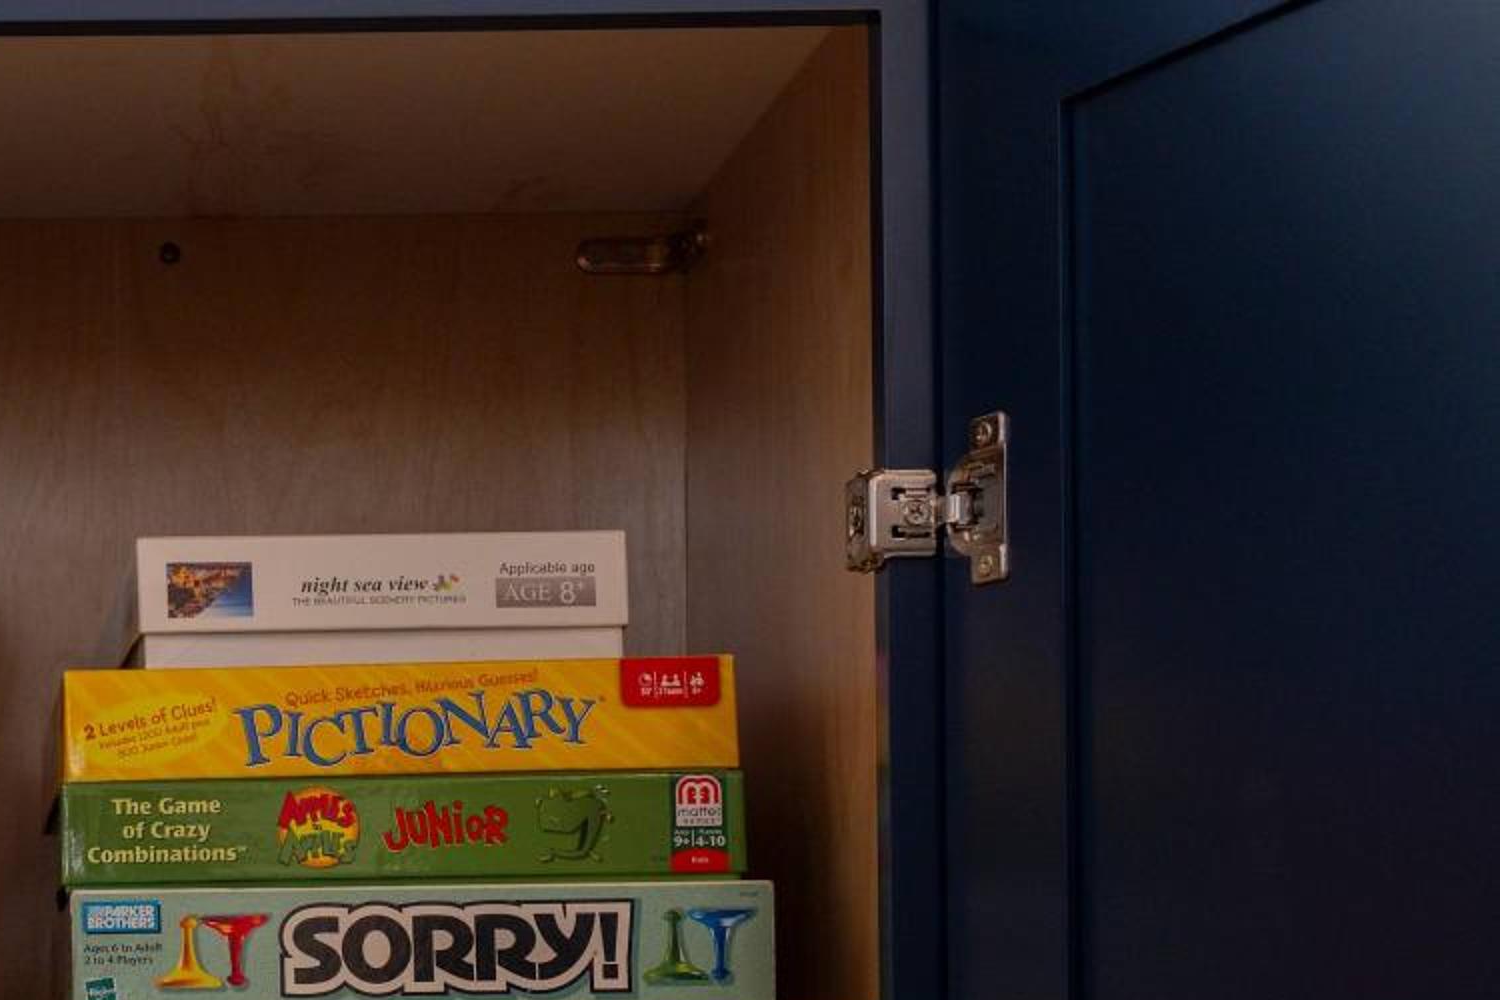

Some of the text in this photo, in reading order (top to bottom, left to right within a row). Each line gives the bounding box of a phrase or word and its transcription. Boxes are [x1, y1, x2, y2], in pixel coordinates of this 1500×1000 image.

[499, 561, 596, 576] Applicable age
[301, 574, 429, 597] night sea view
[504, 580, 550, 602] AGE
[285, 686, 334, 708] Quick
[83, 724, 96, 741] 2
[99, 714, 148, 738] Levels
[150, 709, 168, 726] of
[233, 688, 598, 767] PICTIONARY
[112, 797, 222, 815] The Game
[122, 821, 211, 842] of Crazy
[673, 835, 726, 847] 9+ 4-10
[87, 917, 155, 929] BROTHERS
[281, 899, 632, 996] SORRY!
